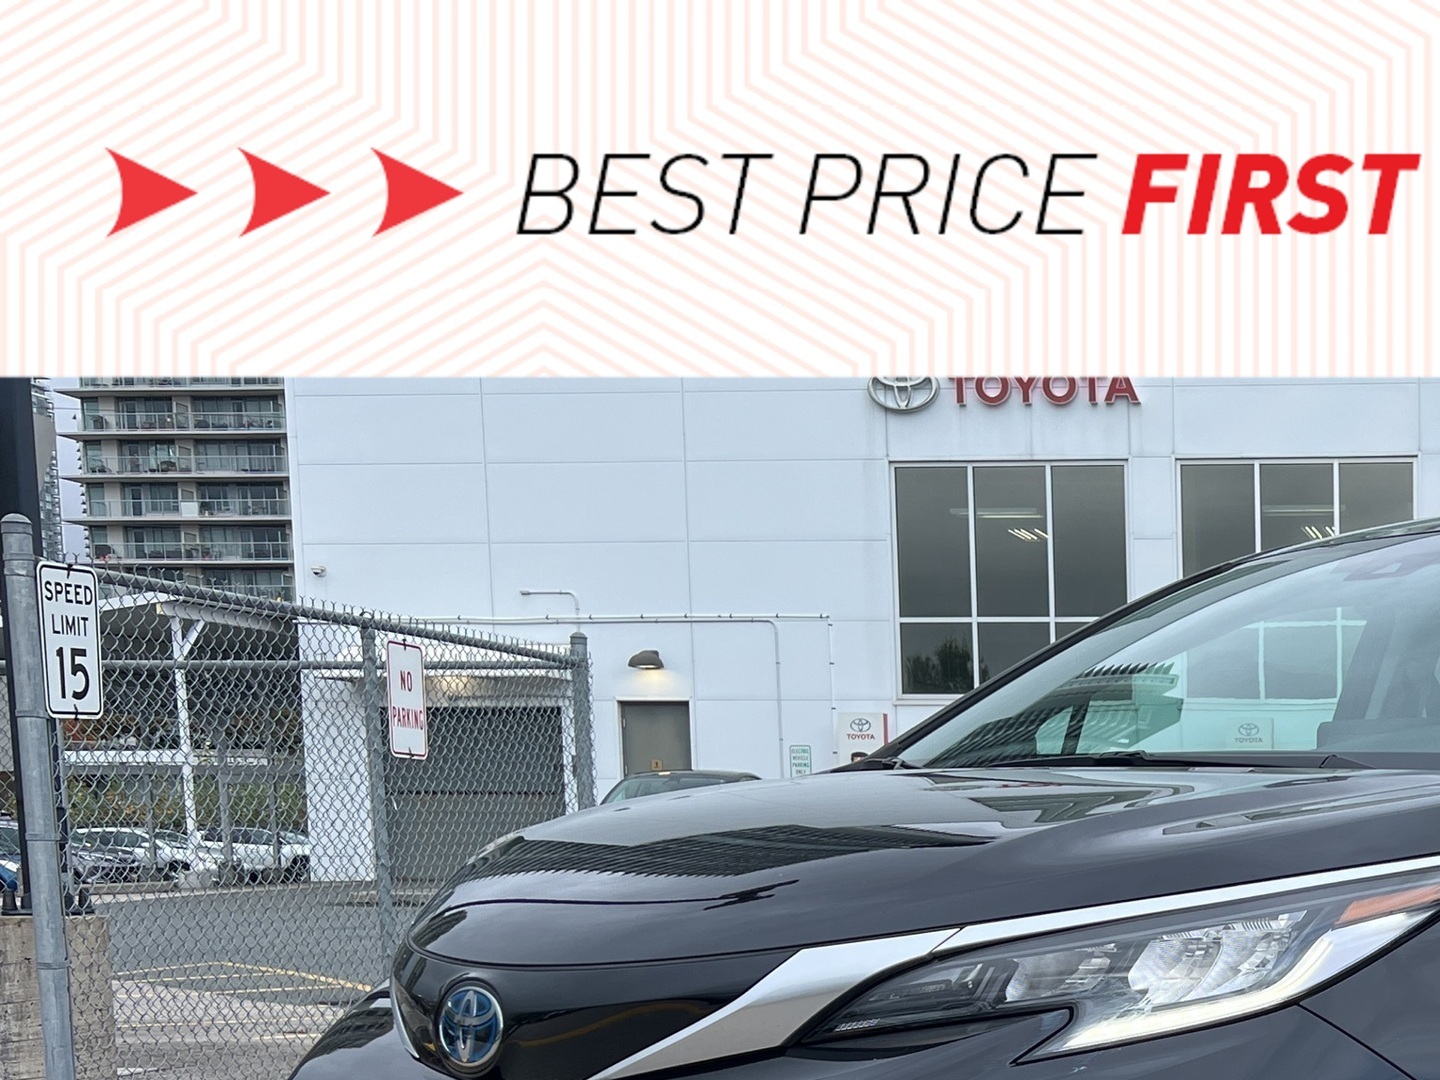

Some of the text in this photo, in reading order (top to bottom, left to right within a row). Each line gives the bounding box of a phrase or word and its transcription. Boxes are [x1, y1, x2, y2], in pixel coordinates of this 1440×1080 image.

[947, 376, 1141, 405] TOYOTA
[44, 580, 93, 606] SPEED
[51, 613, 89, 637] LIMIT
[56, 646, 90, 700] 15
[400, 670, 413, 692] NO
[392, 706, 424, 731] PARKING
[846, 733, 875, 741] TOYOTA
